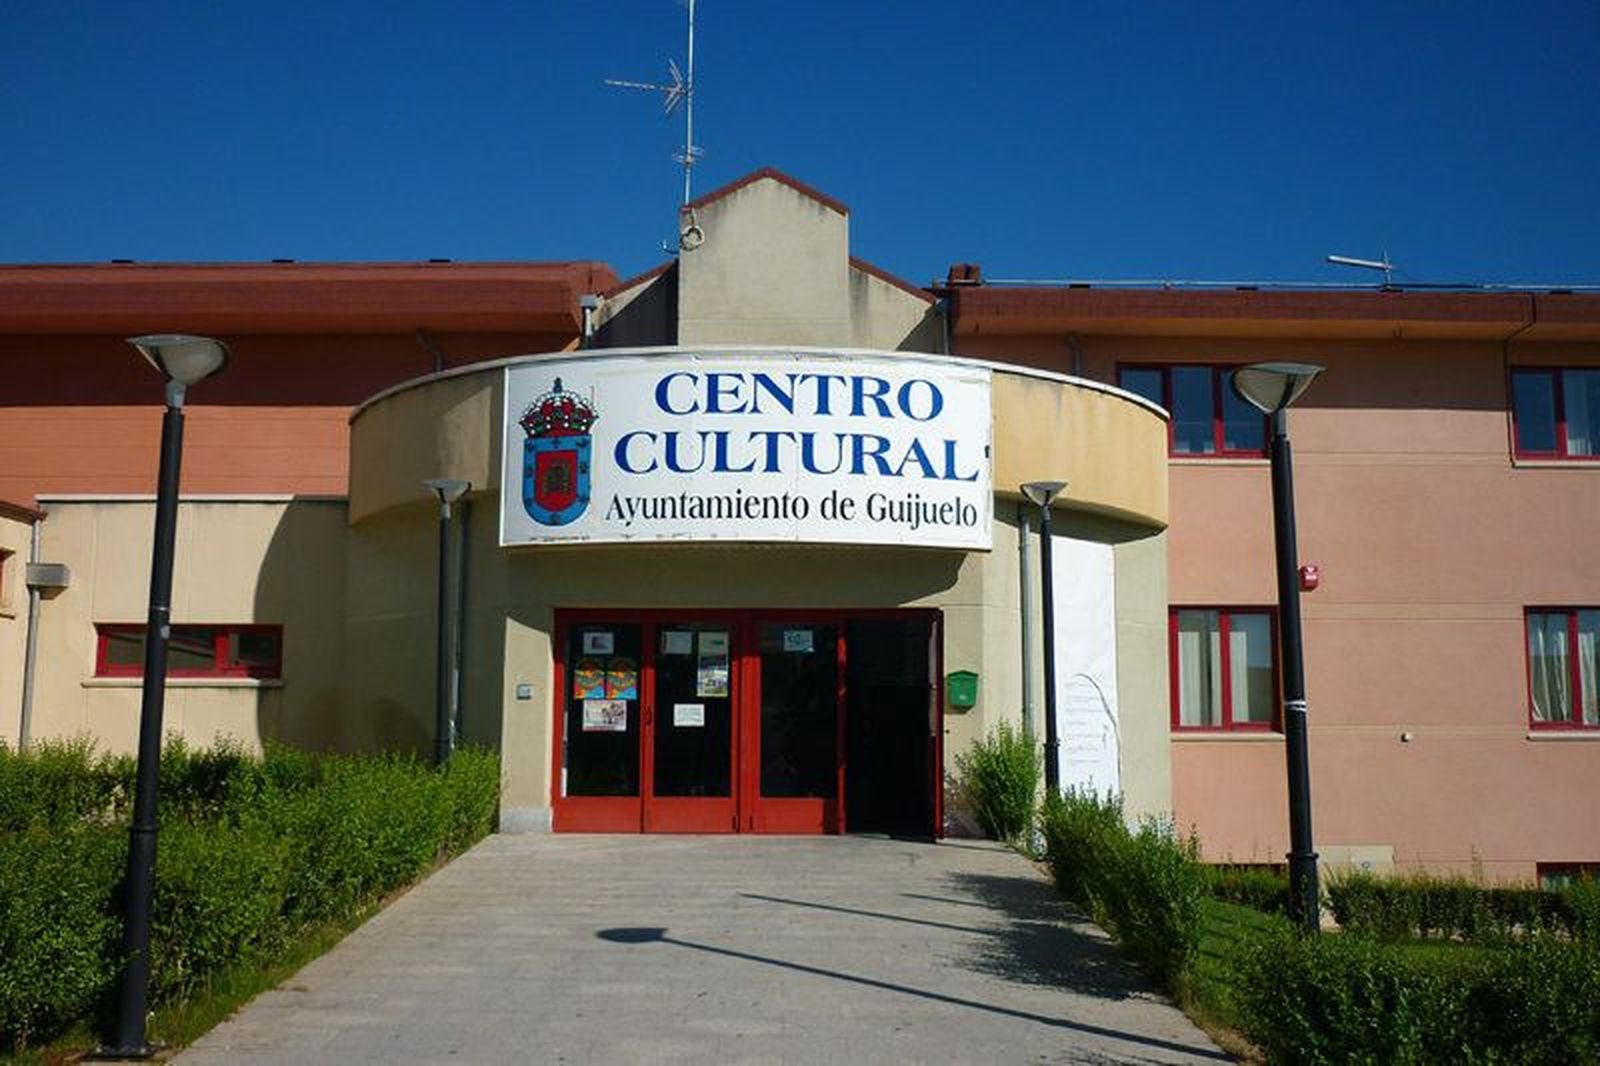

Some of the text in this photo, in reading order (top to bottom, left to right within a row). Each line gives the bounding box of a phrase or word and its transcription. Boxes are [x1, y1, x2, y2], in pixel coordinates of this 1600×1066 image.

[654, 371, 945, 423] CENTRO
[612, 430, 980, 483] CULTURAL
[604, 488, 978, 532] Ayuntamiento de Guijuelo
